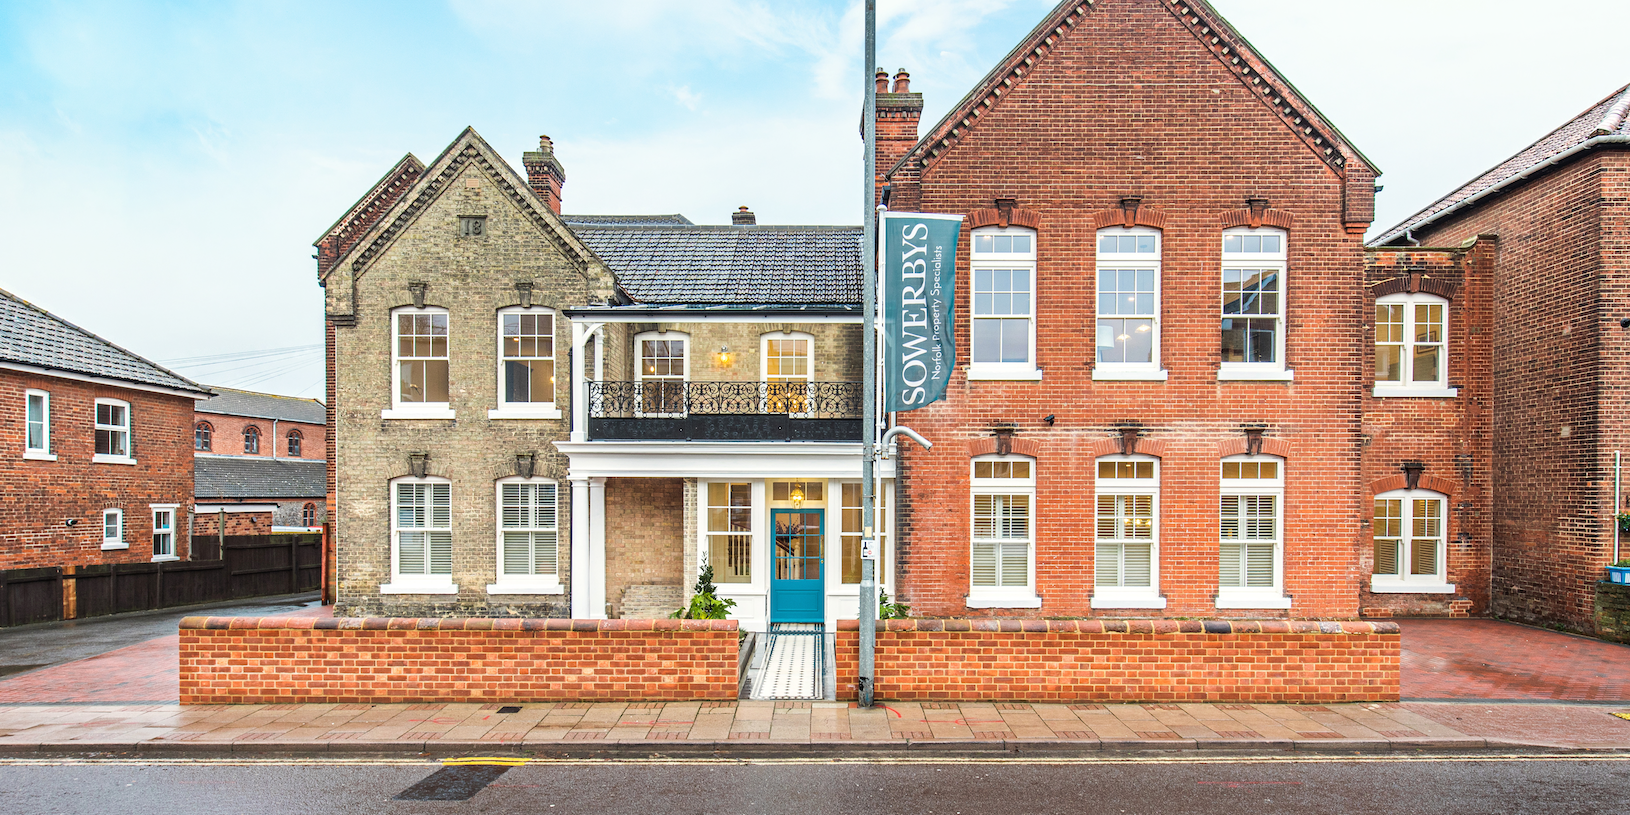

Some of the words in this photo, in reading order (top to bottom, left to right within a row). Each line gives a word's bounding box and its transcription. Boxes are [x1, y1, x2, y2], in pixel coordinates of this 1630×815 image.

[930, 245, 943, 296] Specialists
[902, 223, 928, 405] SOWERBYS
[931, 299, 943, 342] Property
[931, 343, 942, 380] Norfolk
